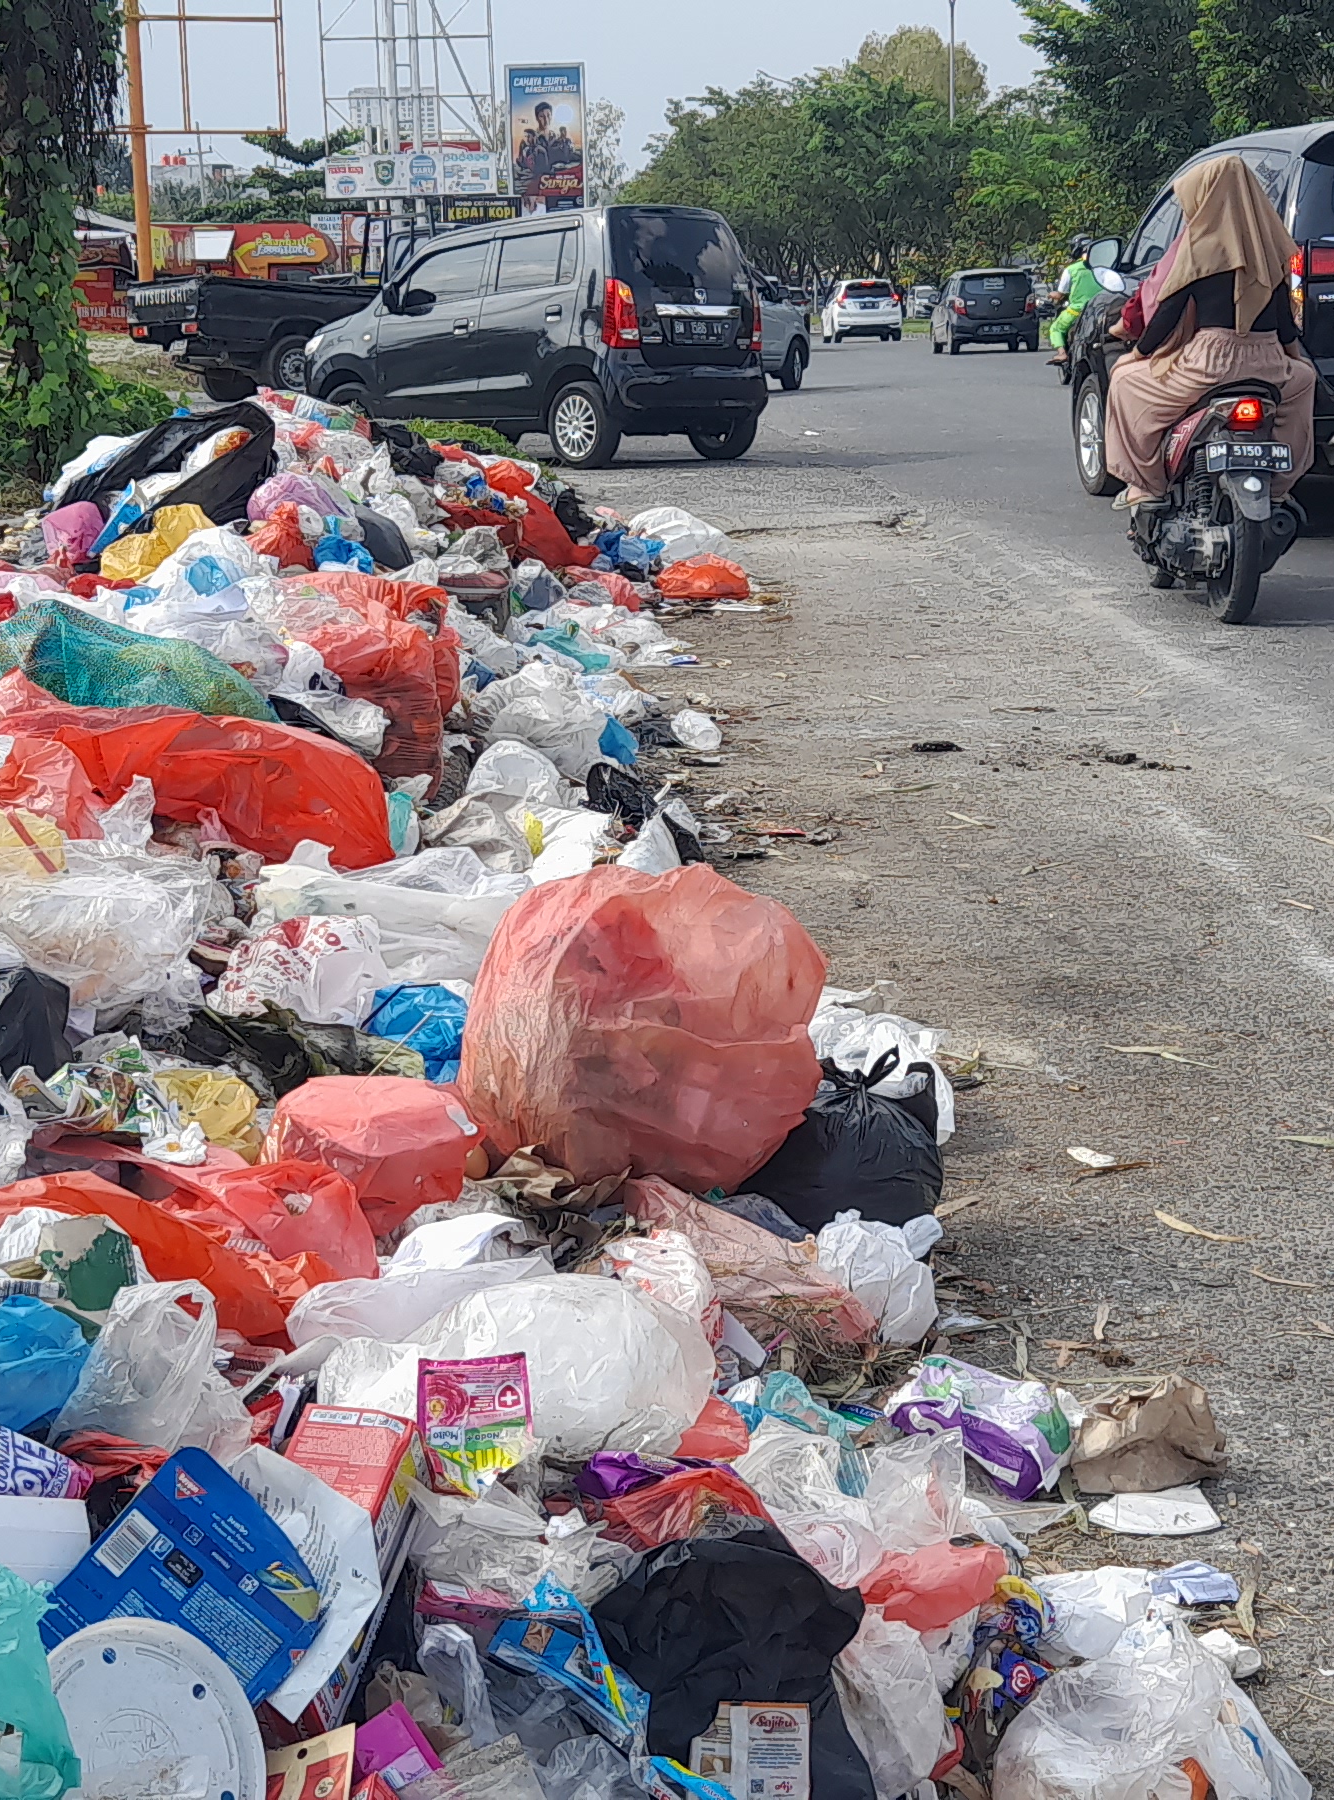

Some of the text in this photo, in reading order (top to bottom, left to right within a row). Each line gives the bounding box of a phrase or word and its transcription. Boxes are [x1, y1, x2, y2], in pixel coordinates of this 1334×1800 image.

[447, 206, 516, 221] KEDAI KOPI
[134, 287, 187, 307] MITSUBISHI
[1209, 444, 1227, 459] BM
[1233, 445, 1263, 457] 5150
